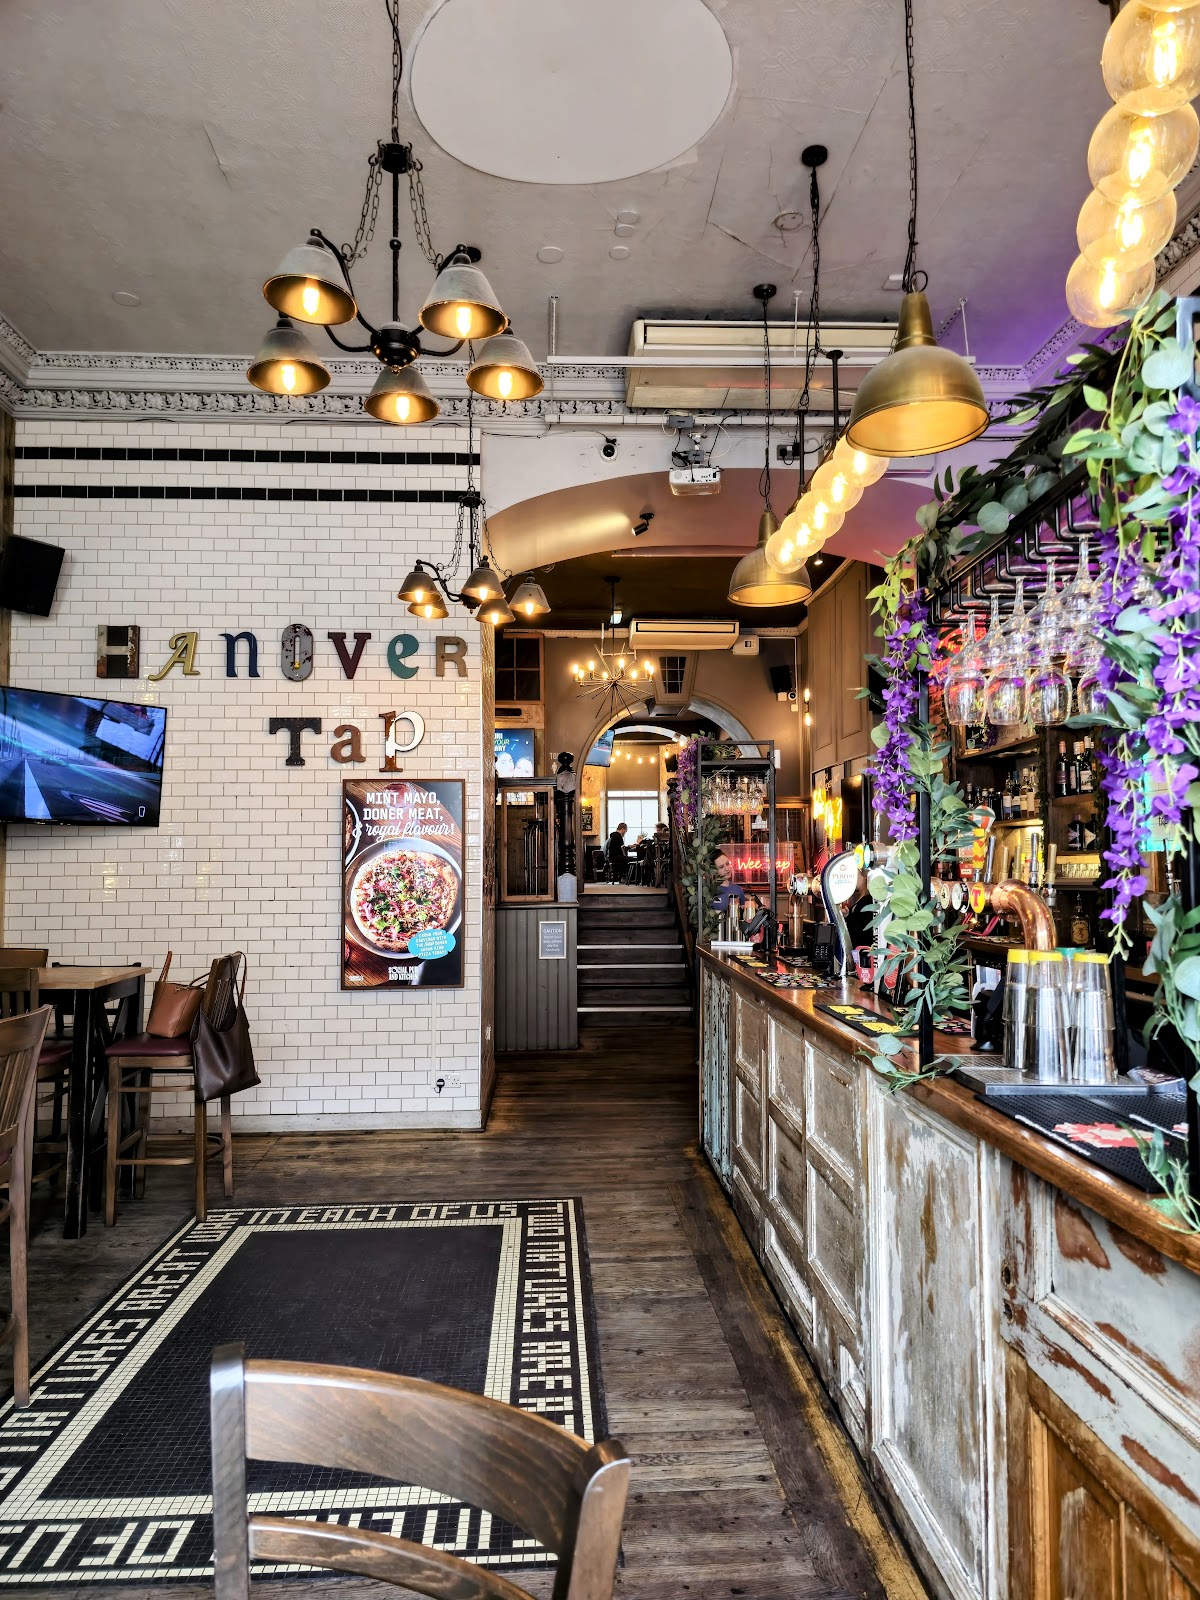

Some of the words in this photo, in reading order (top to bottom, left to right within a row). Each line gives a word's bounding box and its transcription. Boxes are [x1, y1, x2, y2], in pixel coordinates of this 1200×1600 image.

[269, 710, 425, 773] Tap
[366, 792, 399, 804] MINT
[403, 791, 441, 806] MAYO,
[363, 807, 404, 820] DONER
[408, 807, 444, 821] MEAT,
[365, 821, 402, 843] royal
[401, 821, 455, 839] flavour!
[737, 857, 762, 870] Wee
[246, 1210, 292, 1225] IN
[300, 1207, 399, 1223] EACH
[409, 1205, 463, 1219] OF
[468, 1203, 518, 1218] US
